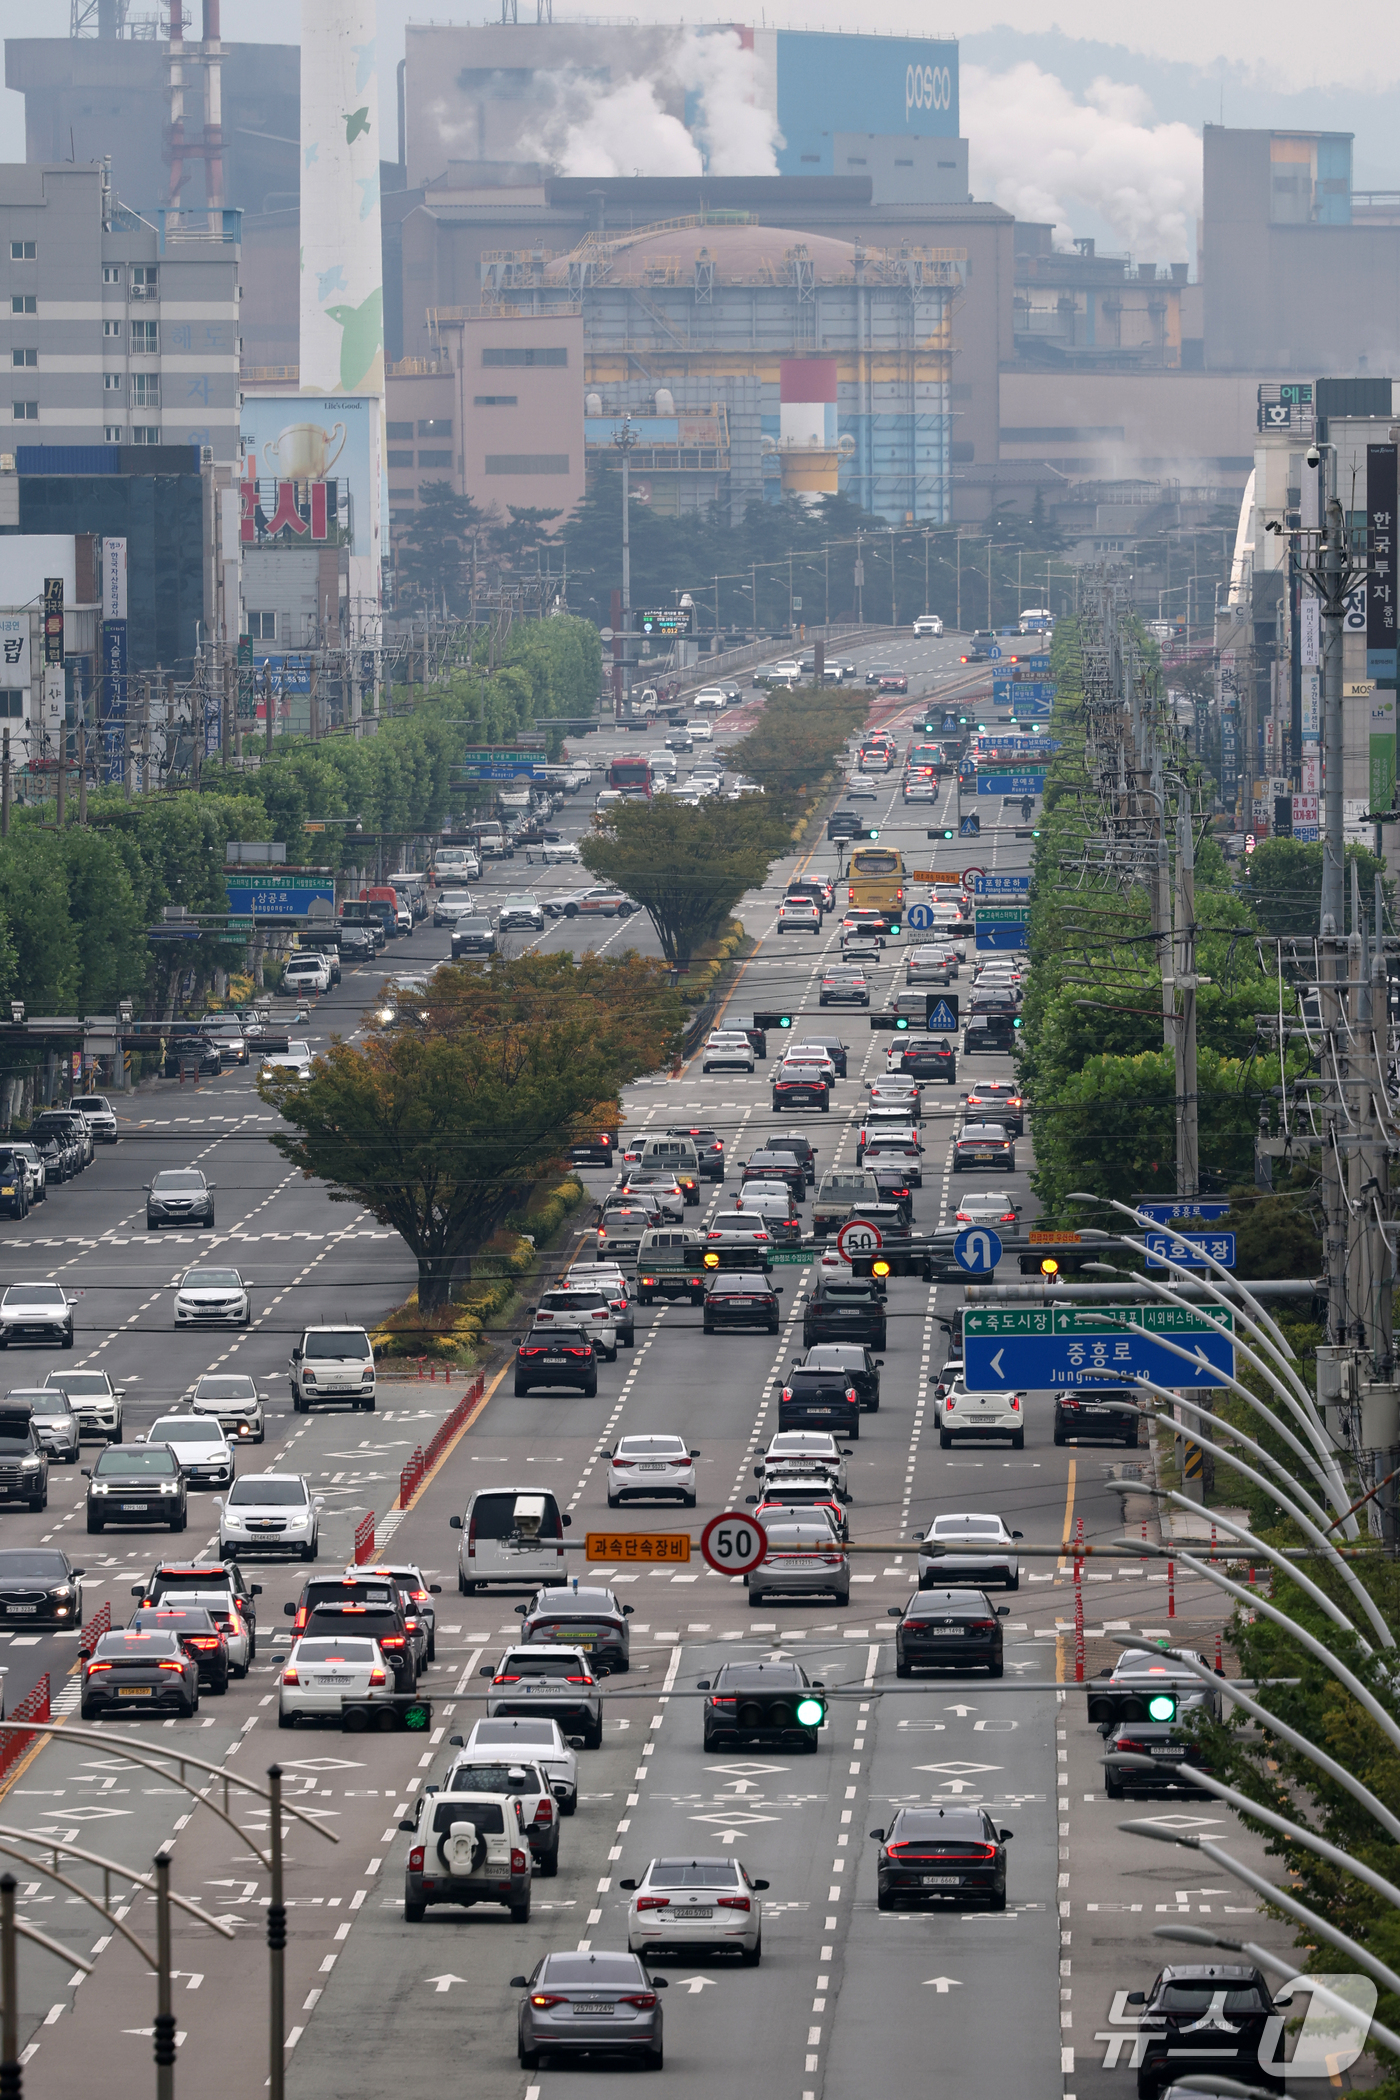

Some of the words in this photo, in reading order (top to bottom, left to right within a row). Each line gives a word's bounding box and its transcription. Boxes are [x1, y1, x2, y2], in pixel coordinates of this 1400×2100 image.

[906, 64, 950, 123] posco
[1266, 404, 1290, 426] 호
[1373, 512, 1392, 602] 한국투자
[1383, 606, 1394, 628] 증권
[110, 552, 118, 618] 한국자산관리공사
[4, 637, 24, 664] 럽
[1198, 709, 1206, 753] HOTEL
[258, 892, 288, 904] 상공로
[986, 912, 1018, 920] 고속버스터미널
[1172, 1206, 1201, 1218] 중흥로
[848, 1233, 871, 1250] 50
[791, 1253, 812, 1262] 수집장치
[986, 1314, 1047, 1331] 죽도시장
[1067, 1342, 1132, 1366] 중흥로
[594, 1538, 683, 1557] 과속단속장비
[717, 1530, 752, 1558] 50
